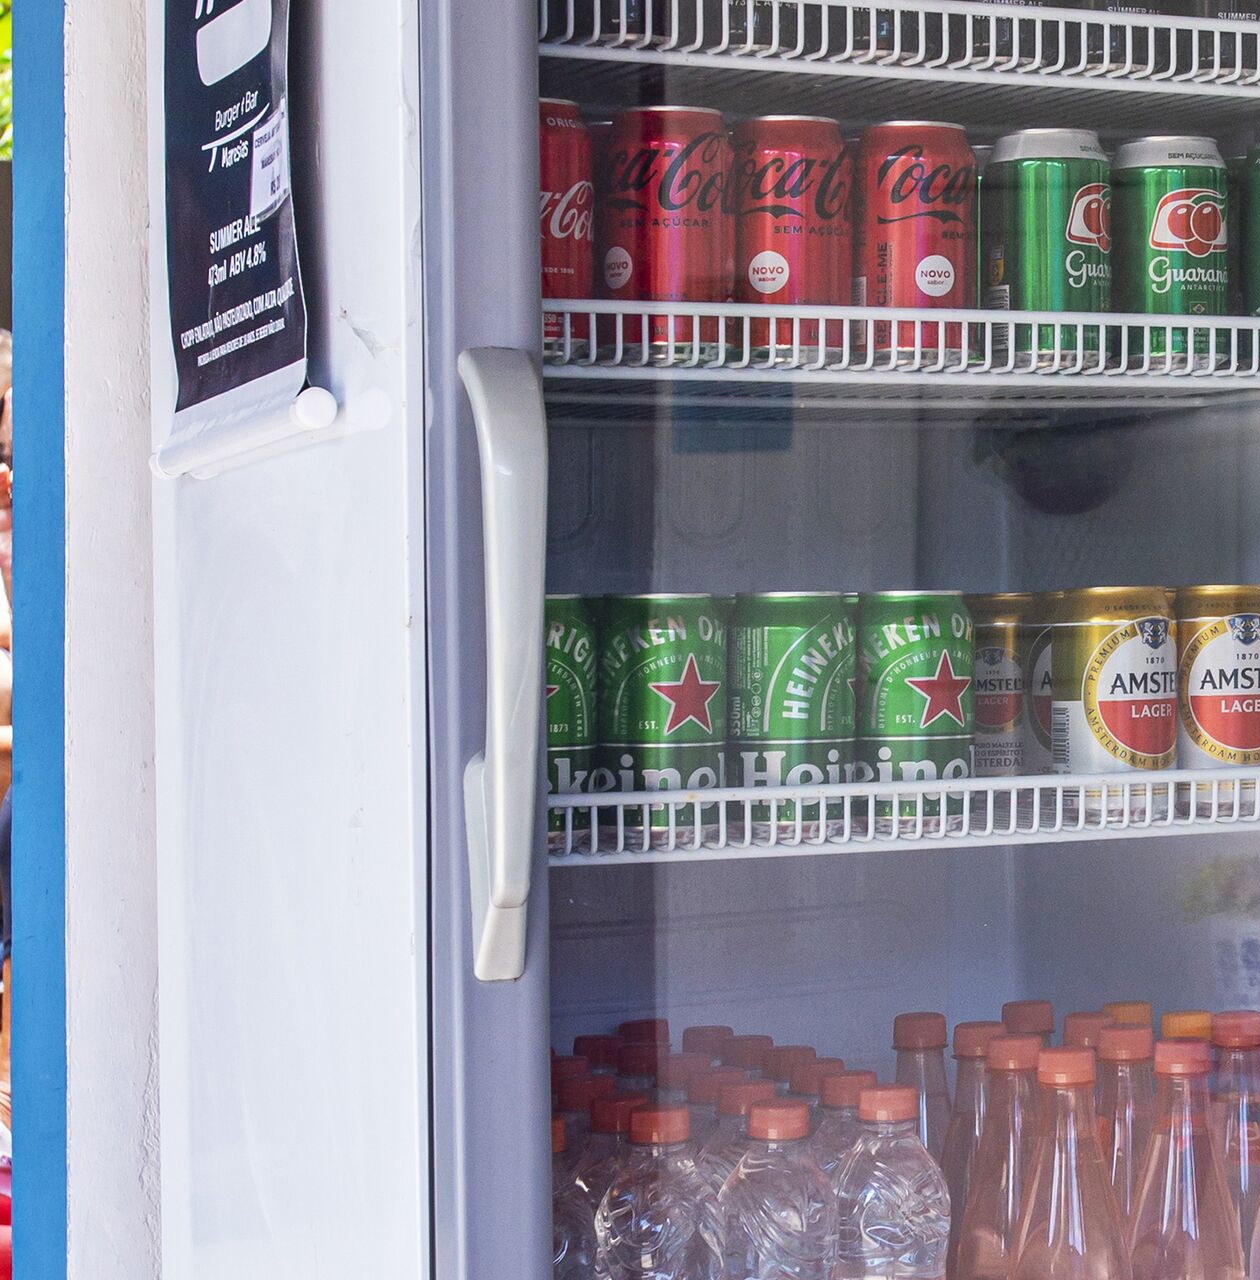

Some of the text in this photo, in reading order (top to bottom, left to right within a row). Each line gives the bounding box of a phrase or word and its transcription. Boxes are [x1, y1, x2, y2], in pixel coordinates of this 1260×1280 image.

[215, 90, 258, 131] Burger Bar
[221, 137, 249, 168] Maresias
[652, 215, 711, 228] AÇÚCAR
[773, 224, 804, 234] SEM
[209, 216, 243, 254] SUMMER
[229, 248, 246, 278] ABV
[246, 241, 267, 269] 4.8%
[752, 266, 785, 276] NOVO
[920, 270, 951, 279] NOVO
[1149, 256, 1228, 294] Guaraná
[1088, 628, 1130, 682] PREMIUM
[1146, 656, 1165, 665] 1870
[1236, 652, 1260, 661] 1870
[975, 677, 1023, 692] MSTEL
[1110, 671, 1177, 695] AMSTE
[895, 714, 916, 723] EST.
[1131, 703, 1173, 719] LAGER
[640, 720, 659, 730] EST.
[1087, 707, 1147, 767] AMSTERDAM
